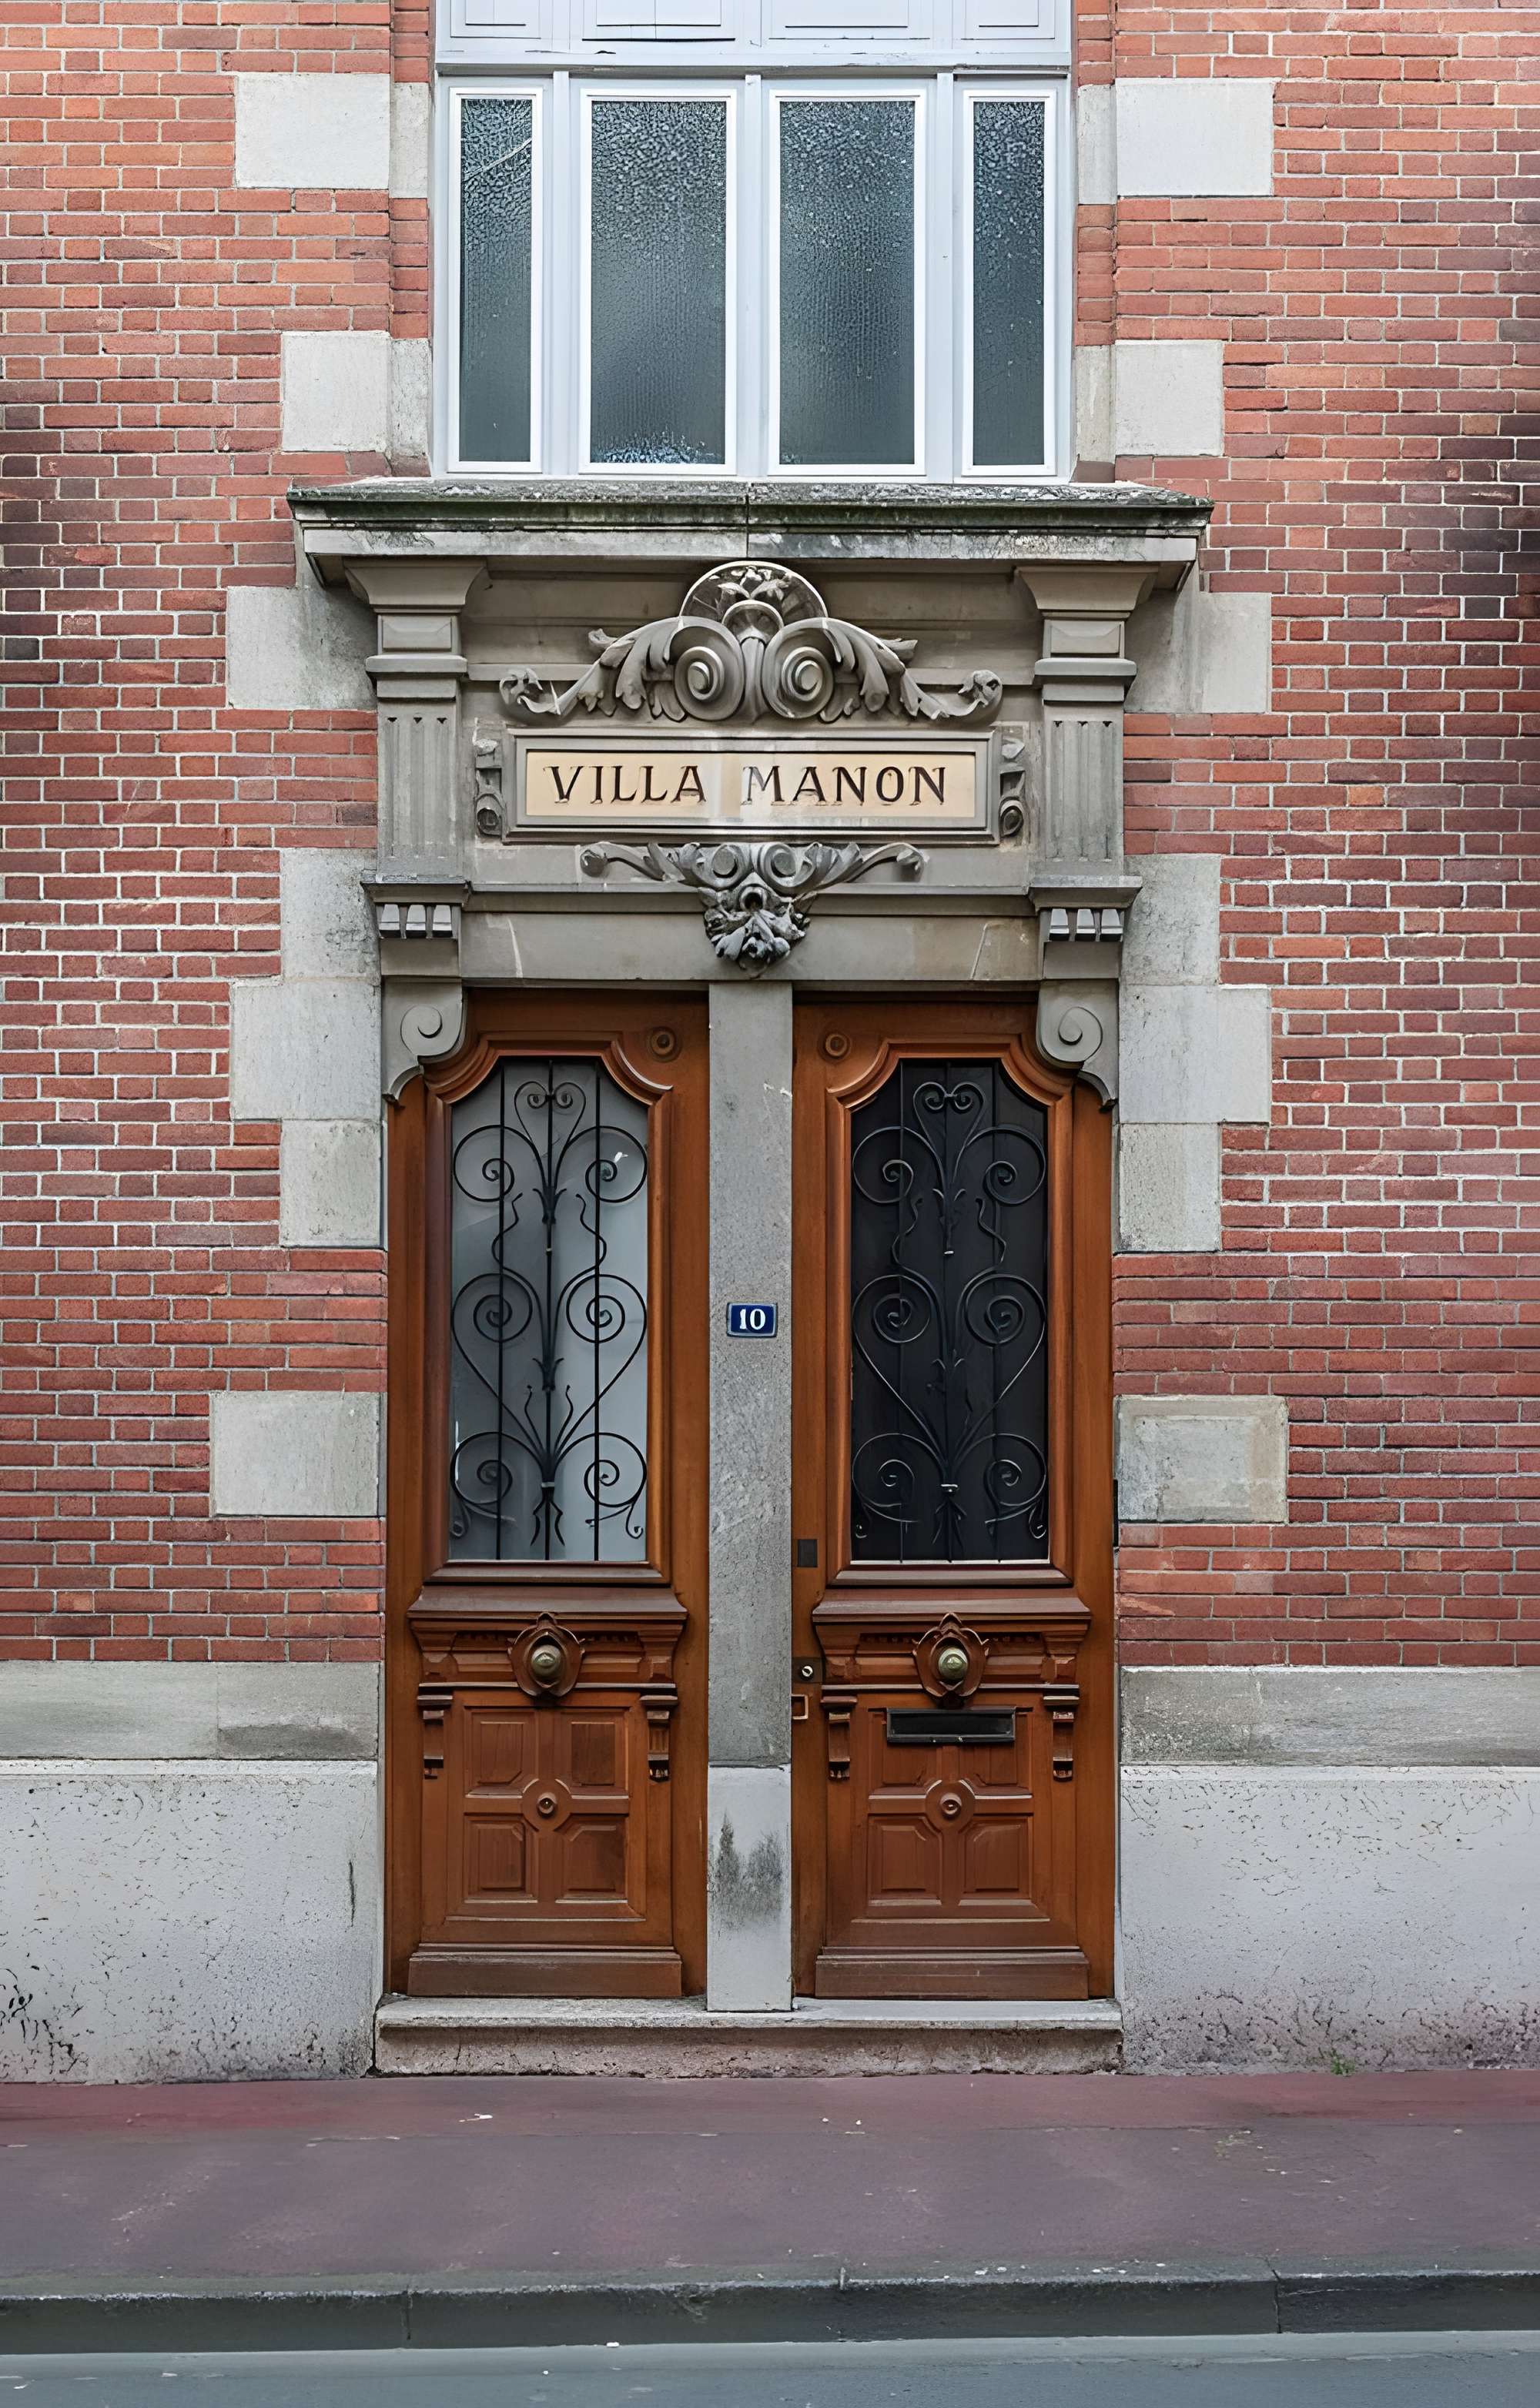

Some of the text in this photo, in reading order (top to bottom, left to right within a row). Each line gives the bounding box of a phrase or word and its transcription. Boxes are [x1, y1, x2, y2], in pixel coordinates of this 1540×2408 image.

[543, 764, 948, 806] VILLA MANON
[739, 1308, 766, 1330] 10
